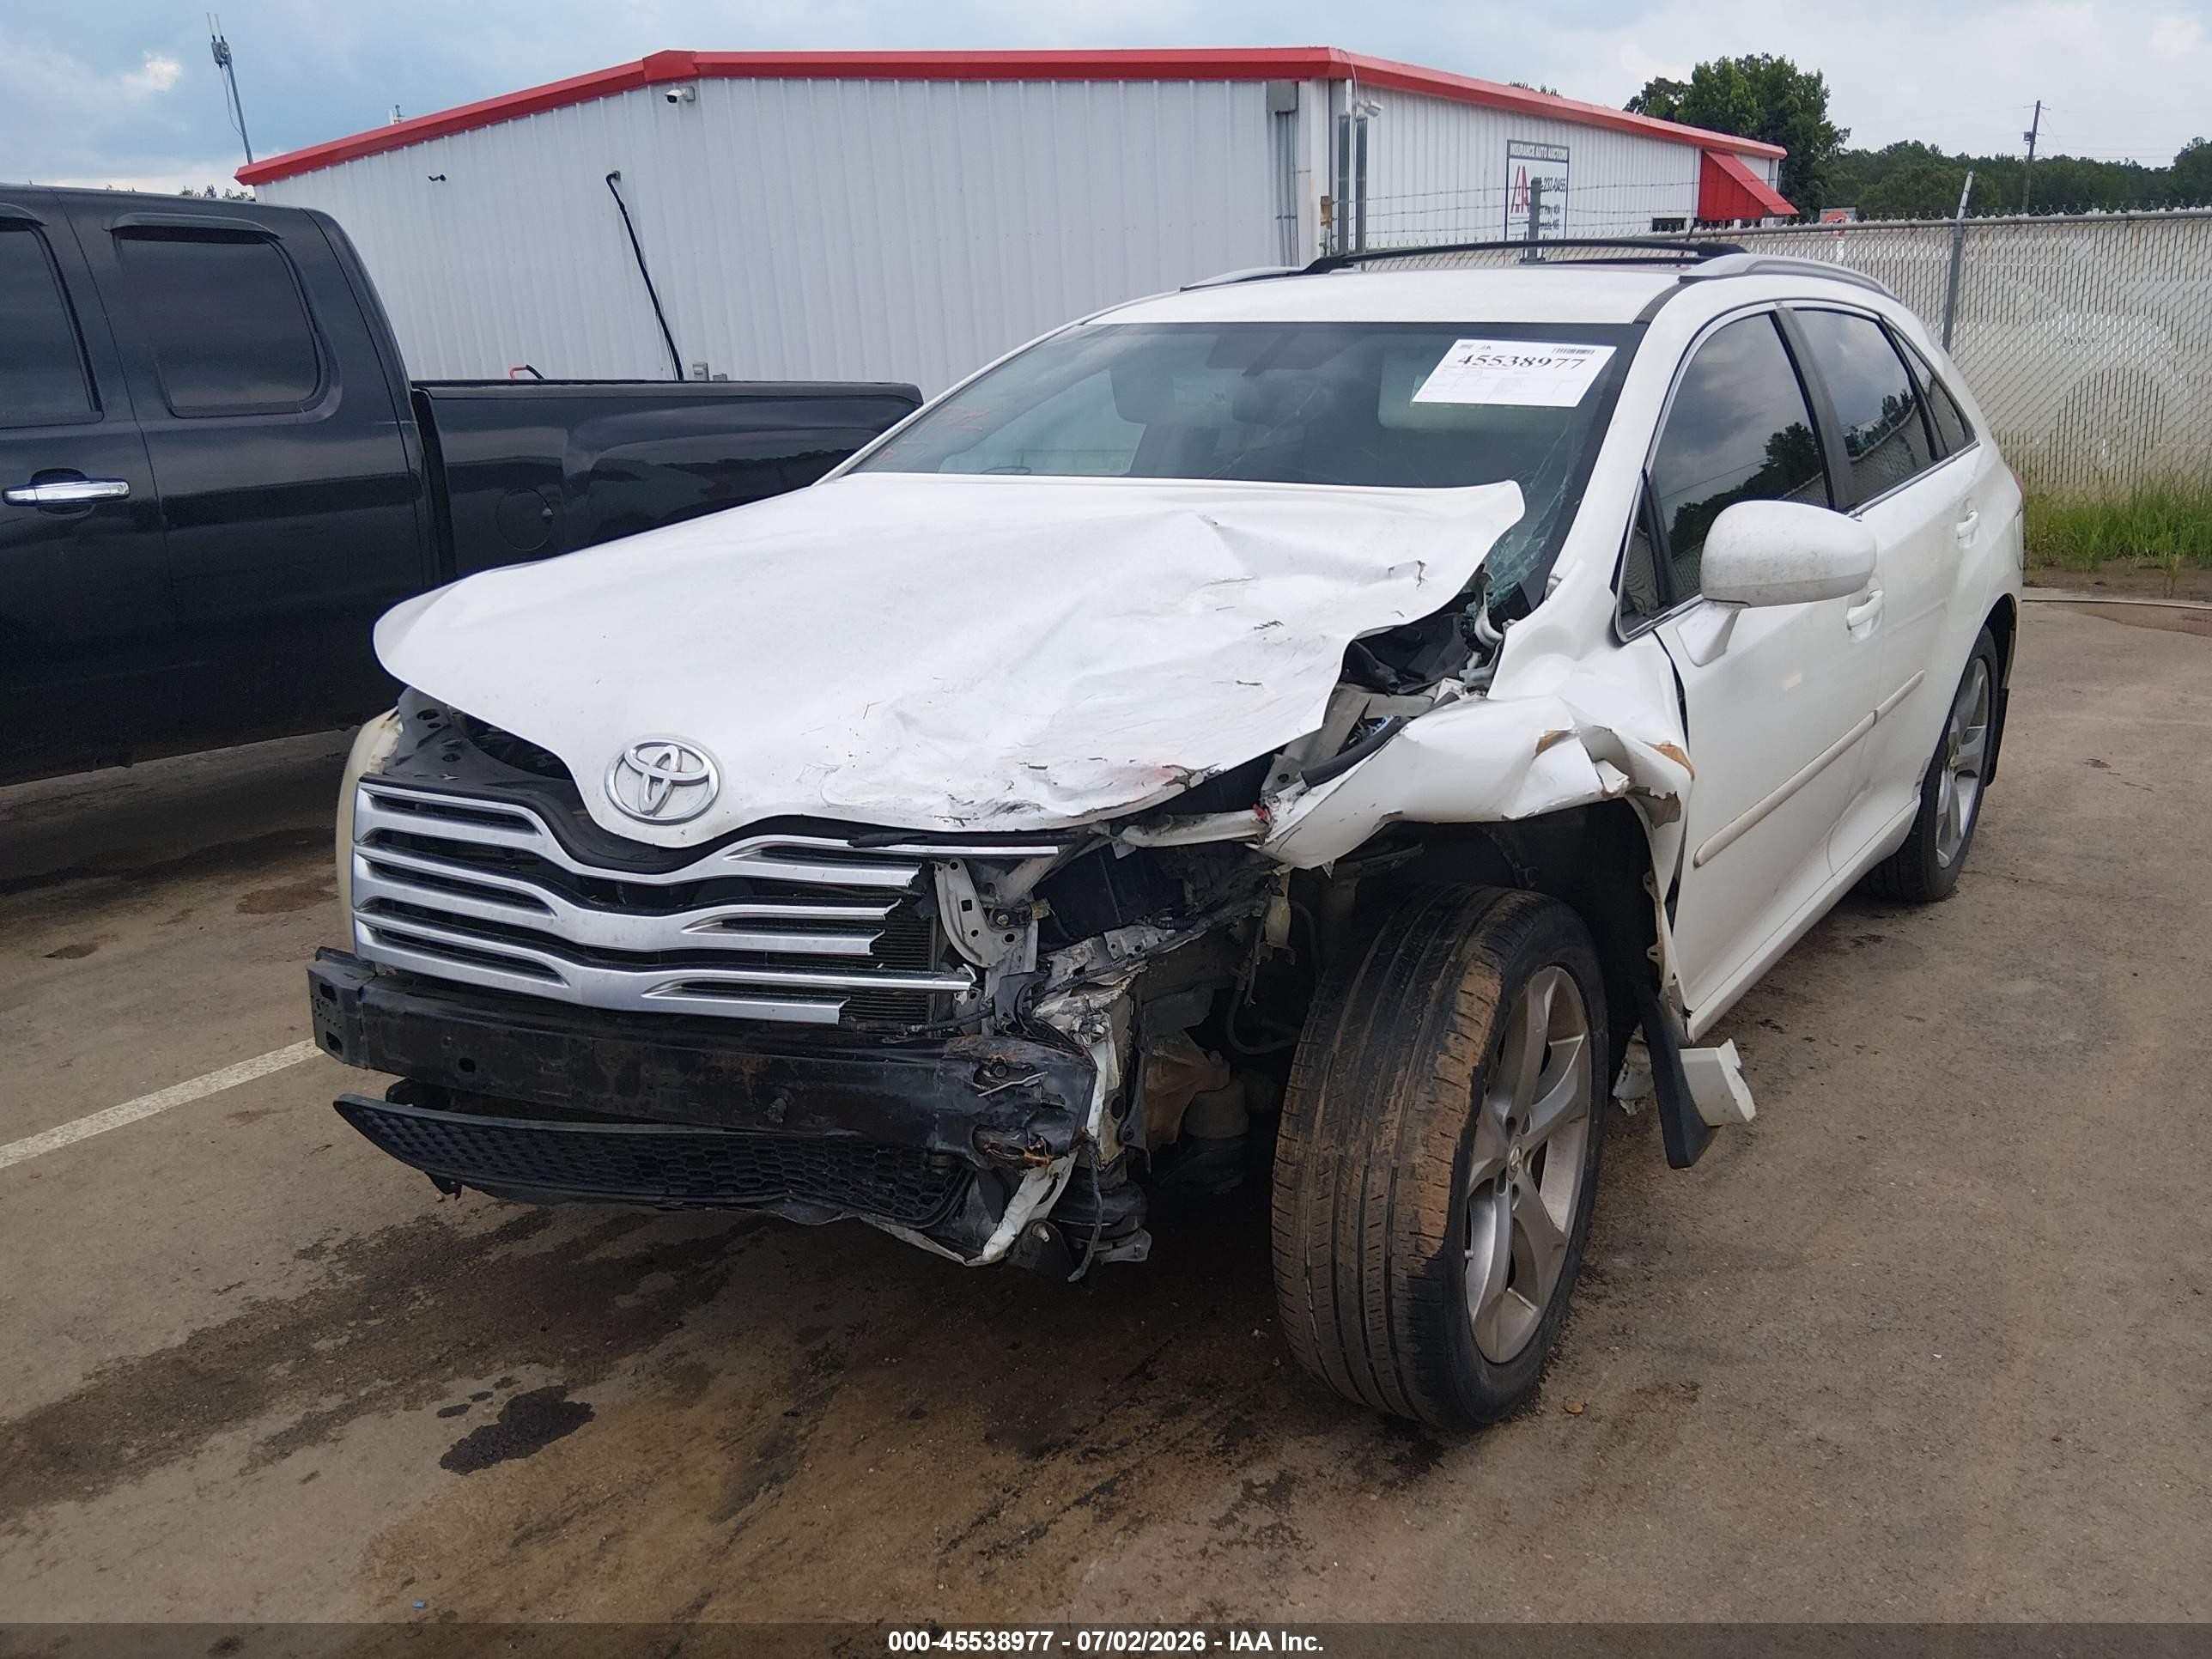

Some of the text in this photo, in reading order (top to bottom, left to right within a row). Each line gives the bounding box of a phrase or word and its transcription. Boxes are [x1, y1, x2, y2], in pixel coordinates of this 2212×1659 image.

[1510, 143, 1568, 161] INSURANCE AUTO AUCTIONS
[1457, 353, 1587, 370] 45538977
